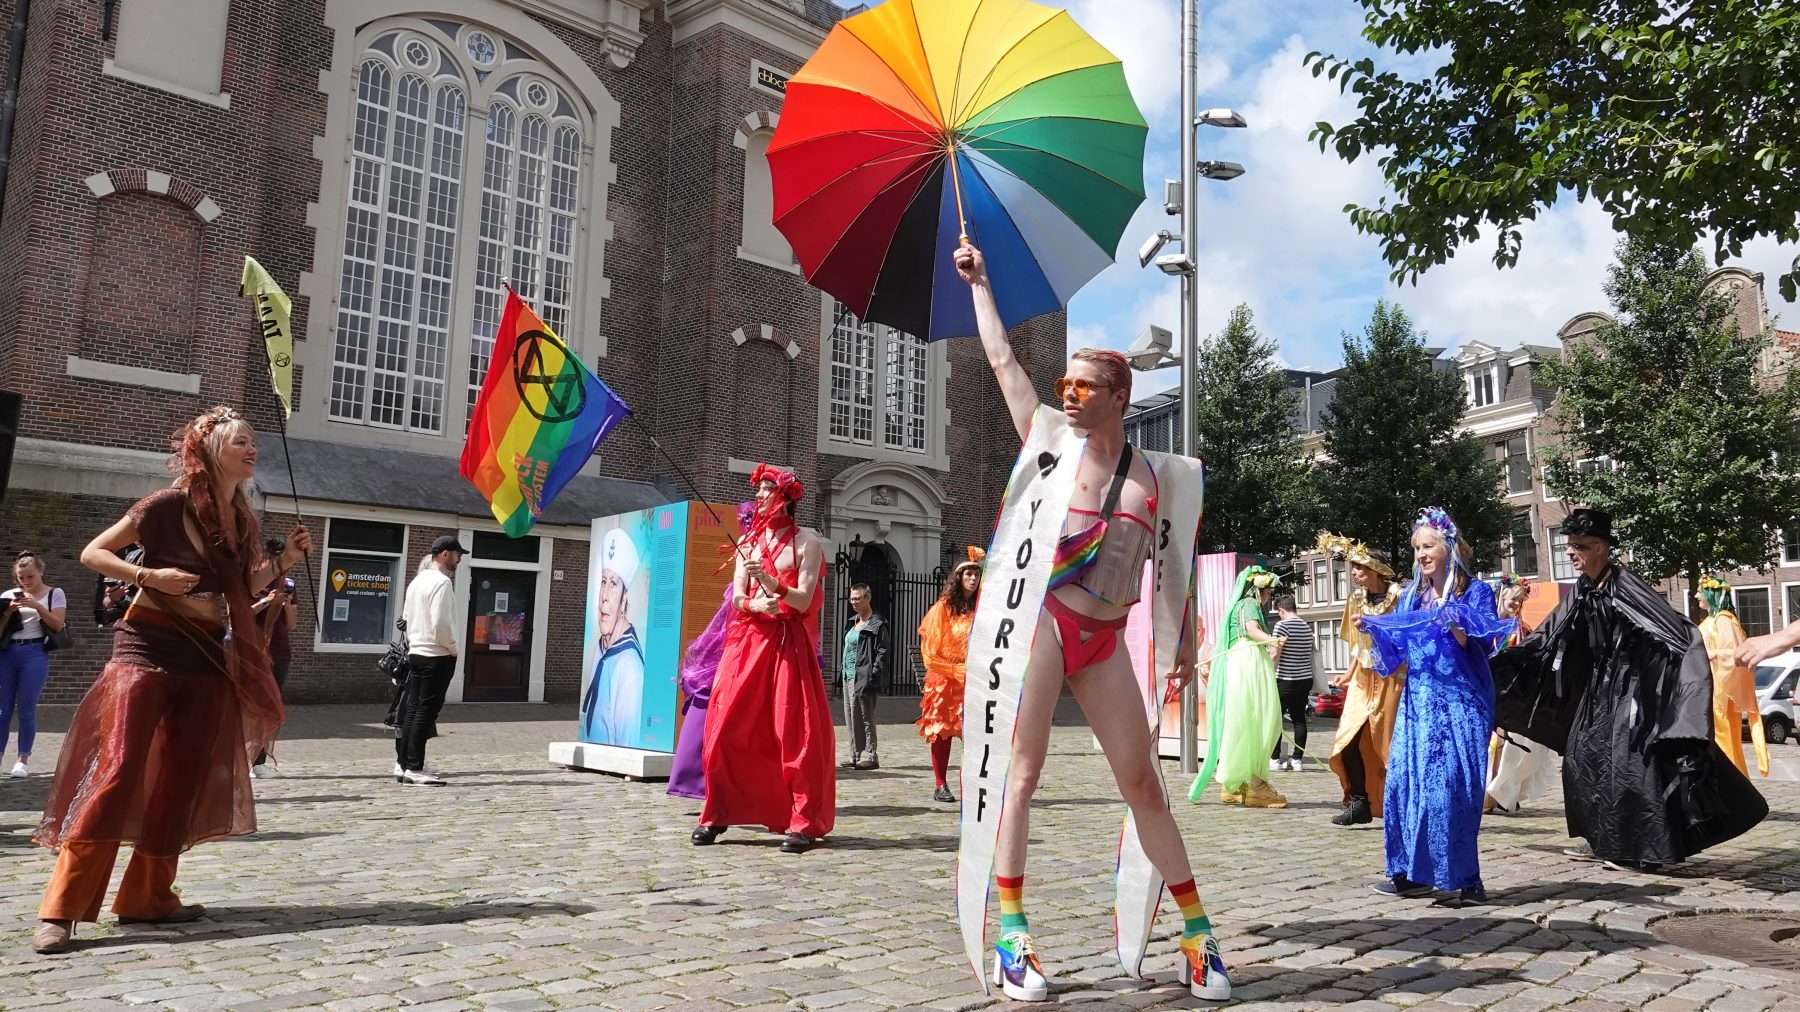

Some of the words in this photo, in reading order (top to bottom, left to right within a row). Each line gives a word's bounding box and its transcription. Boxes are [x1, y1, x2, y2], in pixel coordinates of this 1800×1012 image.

[348, 573, 392, 582] amsterdam
[347, 580, 369, 588] ticket
[371, 581, 390, 591] shop
[977, 498, 1042, 823] YOURSELF
